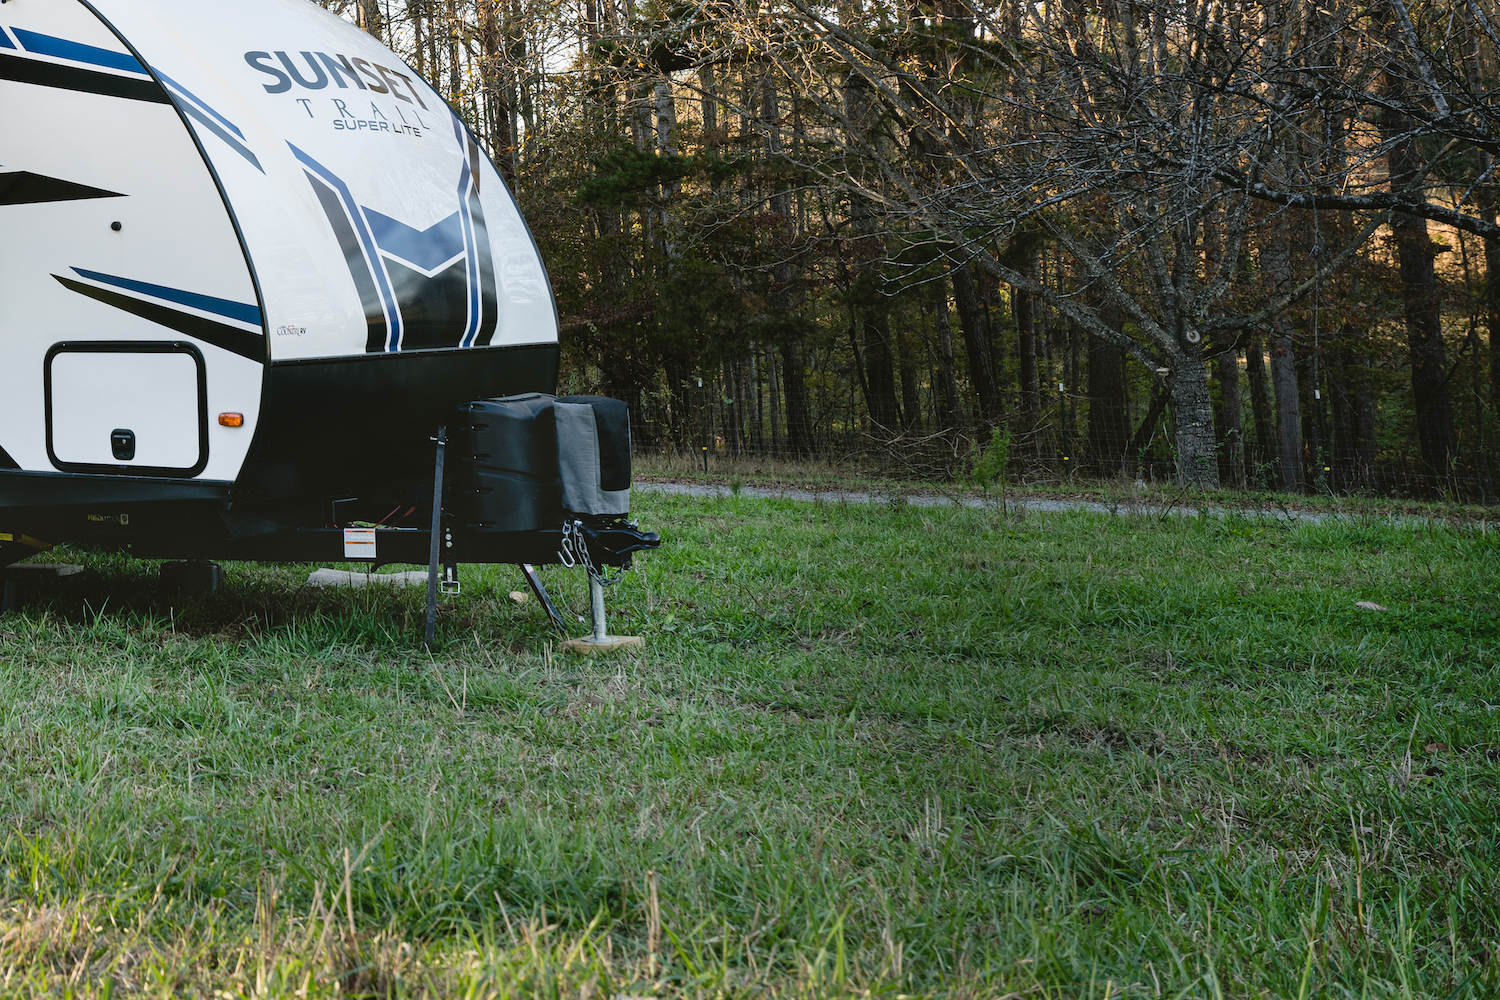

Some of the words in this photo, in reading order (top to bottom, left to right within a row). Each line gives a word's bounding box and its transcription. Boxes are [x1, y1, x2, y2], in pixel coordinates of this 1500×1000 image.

[244, 50, 429, 111] SUNSET
[296, 98, 430, 130] TRAIL
[333, 119, 389, 132] SUPER
[392, 124, 422, 138] LITE
